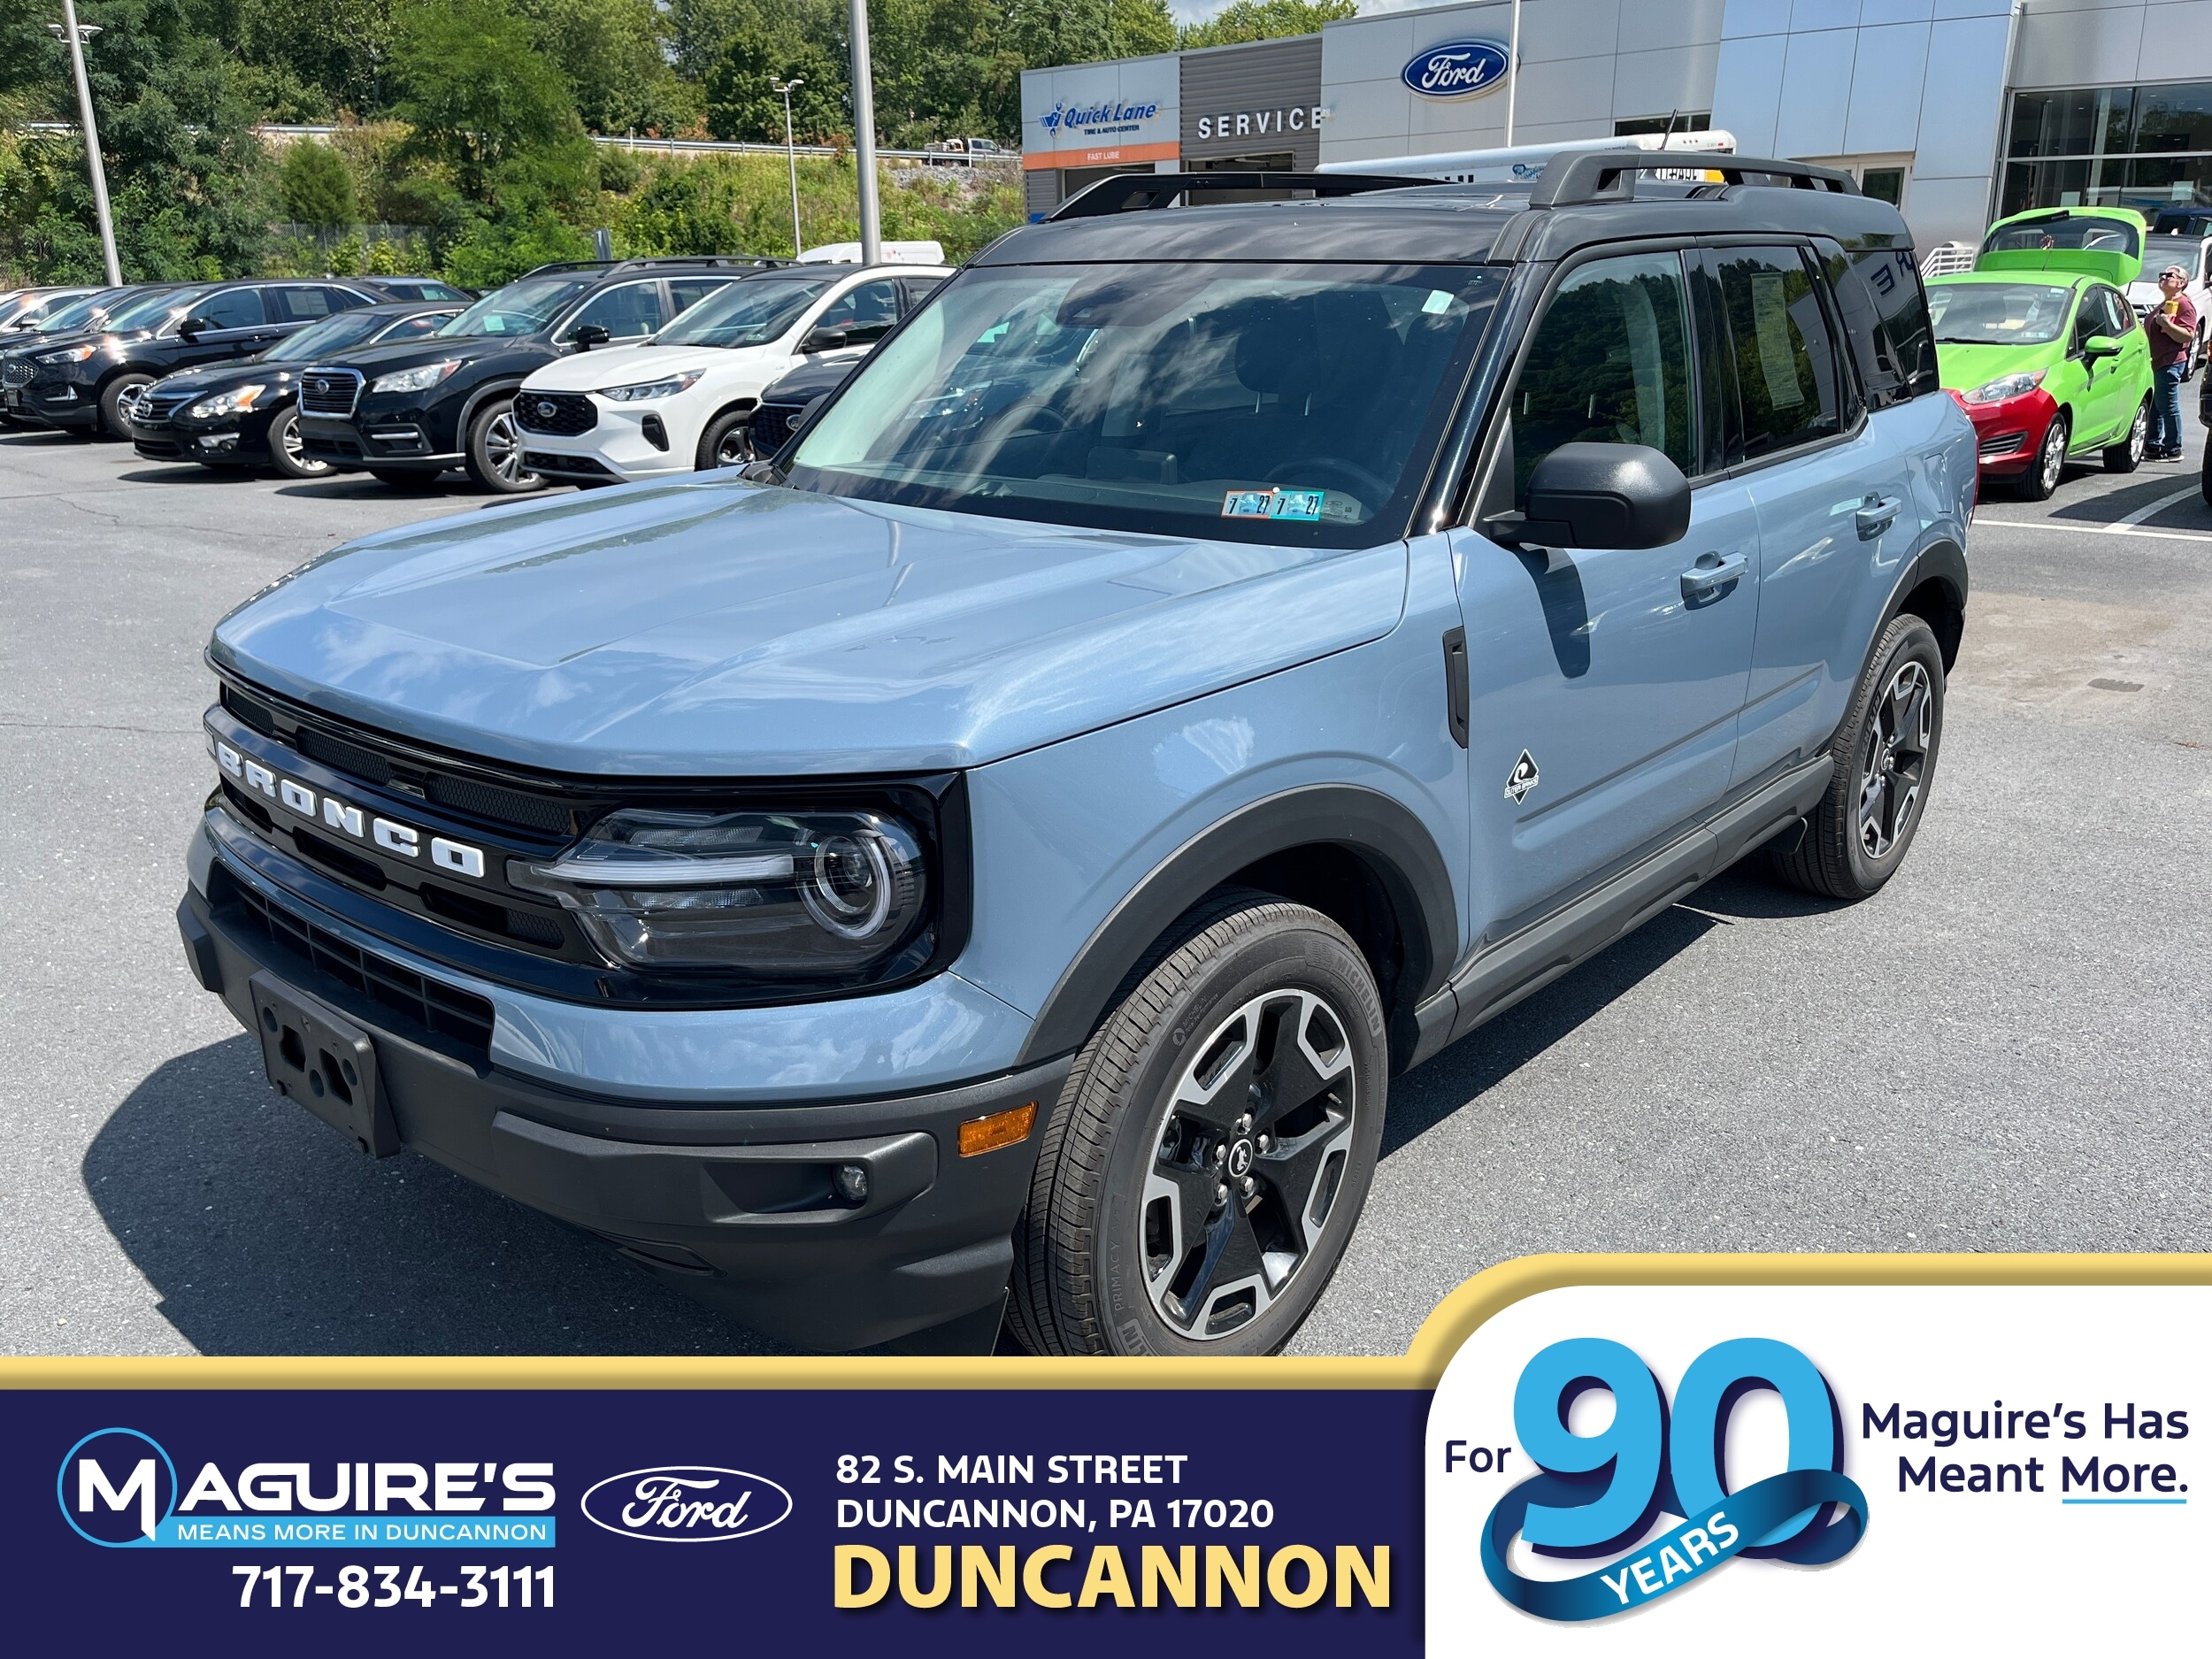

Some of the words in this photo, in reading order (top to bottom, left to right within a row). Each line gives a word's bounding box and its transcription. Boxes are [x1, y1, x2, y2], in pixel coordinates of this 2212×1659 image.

[1421, 52, 1486, 88] Ford
[1064, 104, 1112, 128] Quick
[1112, 104, 1157, 122] Lane
[1117, 124, 1141, 133] CENTER
[1197, 106, 1331, 140] SERVICE
[1087, 152, 1102, 161] FAST
[1103, 150, 1120, 159] LUBE
[1256, 495, 1271, 515] 27
[1305, 495, 1319, 516] 27
[218, 741, 486, 879] BRONCO
[1334, 956, 1381, 1032] MICHELIN
[1110, 1240, 1125, 1311] PRIMACY
